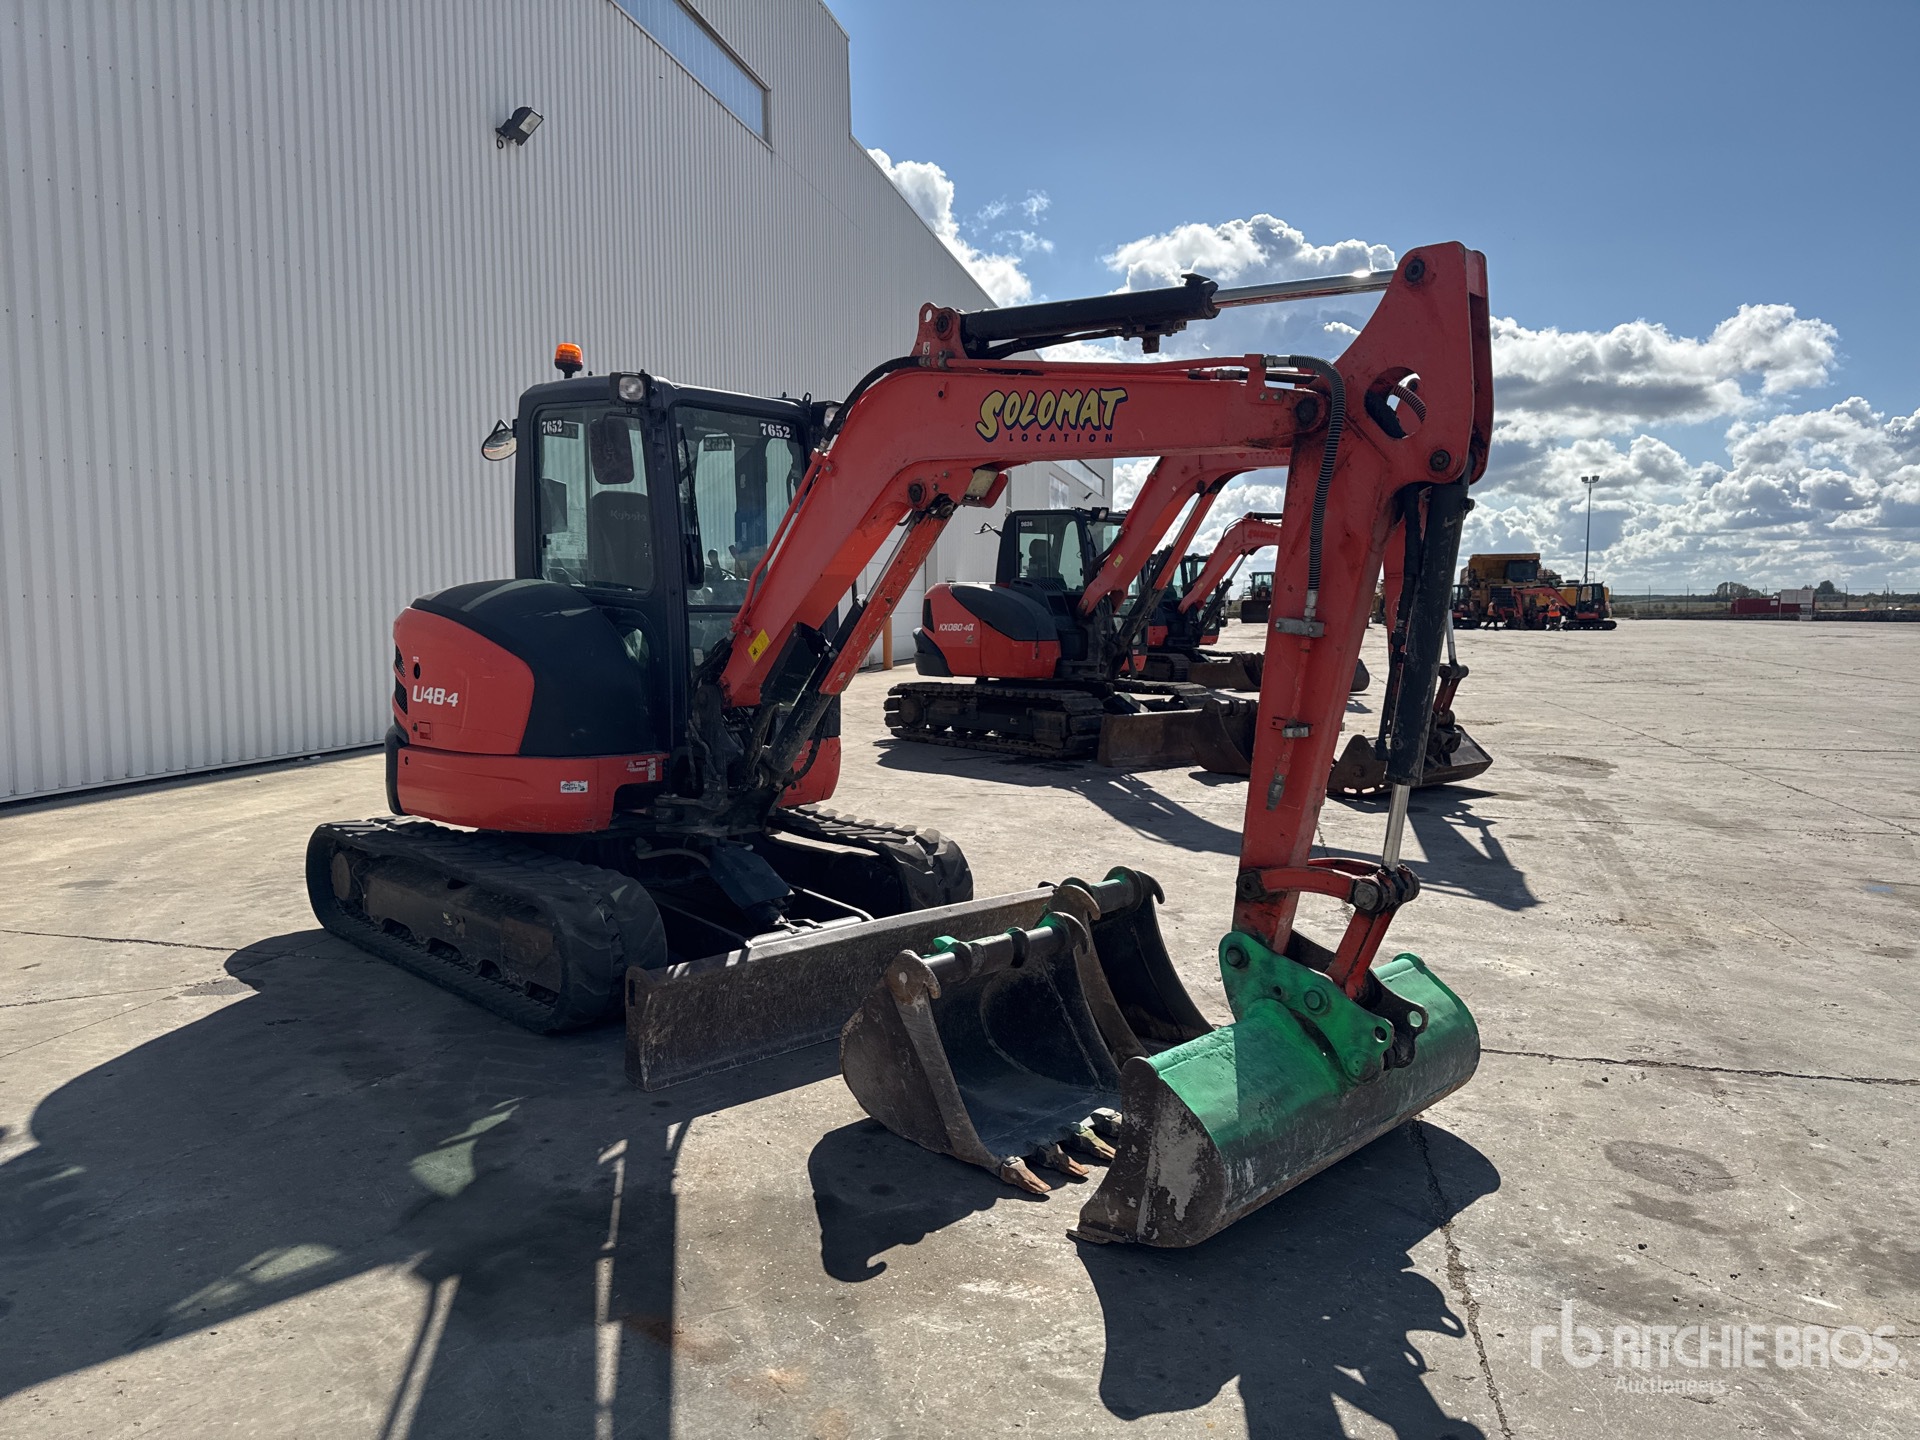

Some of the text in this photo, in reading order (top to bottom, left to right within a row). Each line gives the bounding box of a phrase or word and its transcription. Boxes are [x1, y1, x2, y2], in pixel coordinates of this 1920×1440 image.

[975, 387, 1128, 443] SOLOMAT
[541, 419, 563, 434] 7652
[760, 423, 791, 438] 7652
[1008, 433, 1113, 443] LOCATION
[412, 685, 459, 707] U48-4
